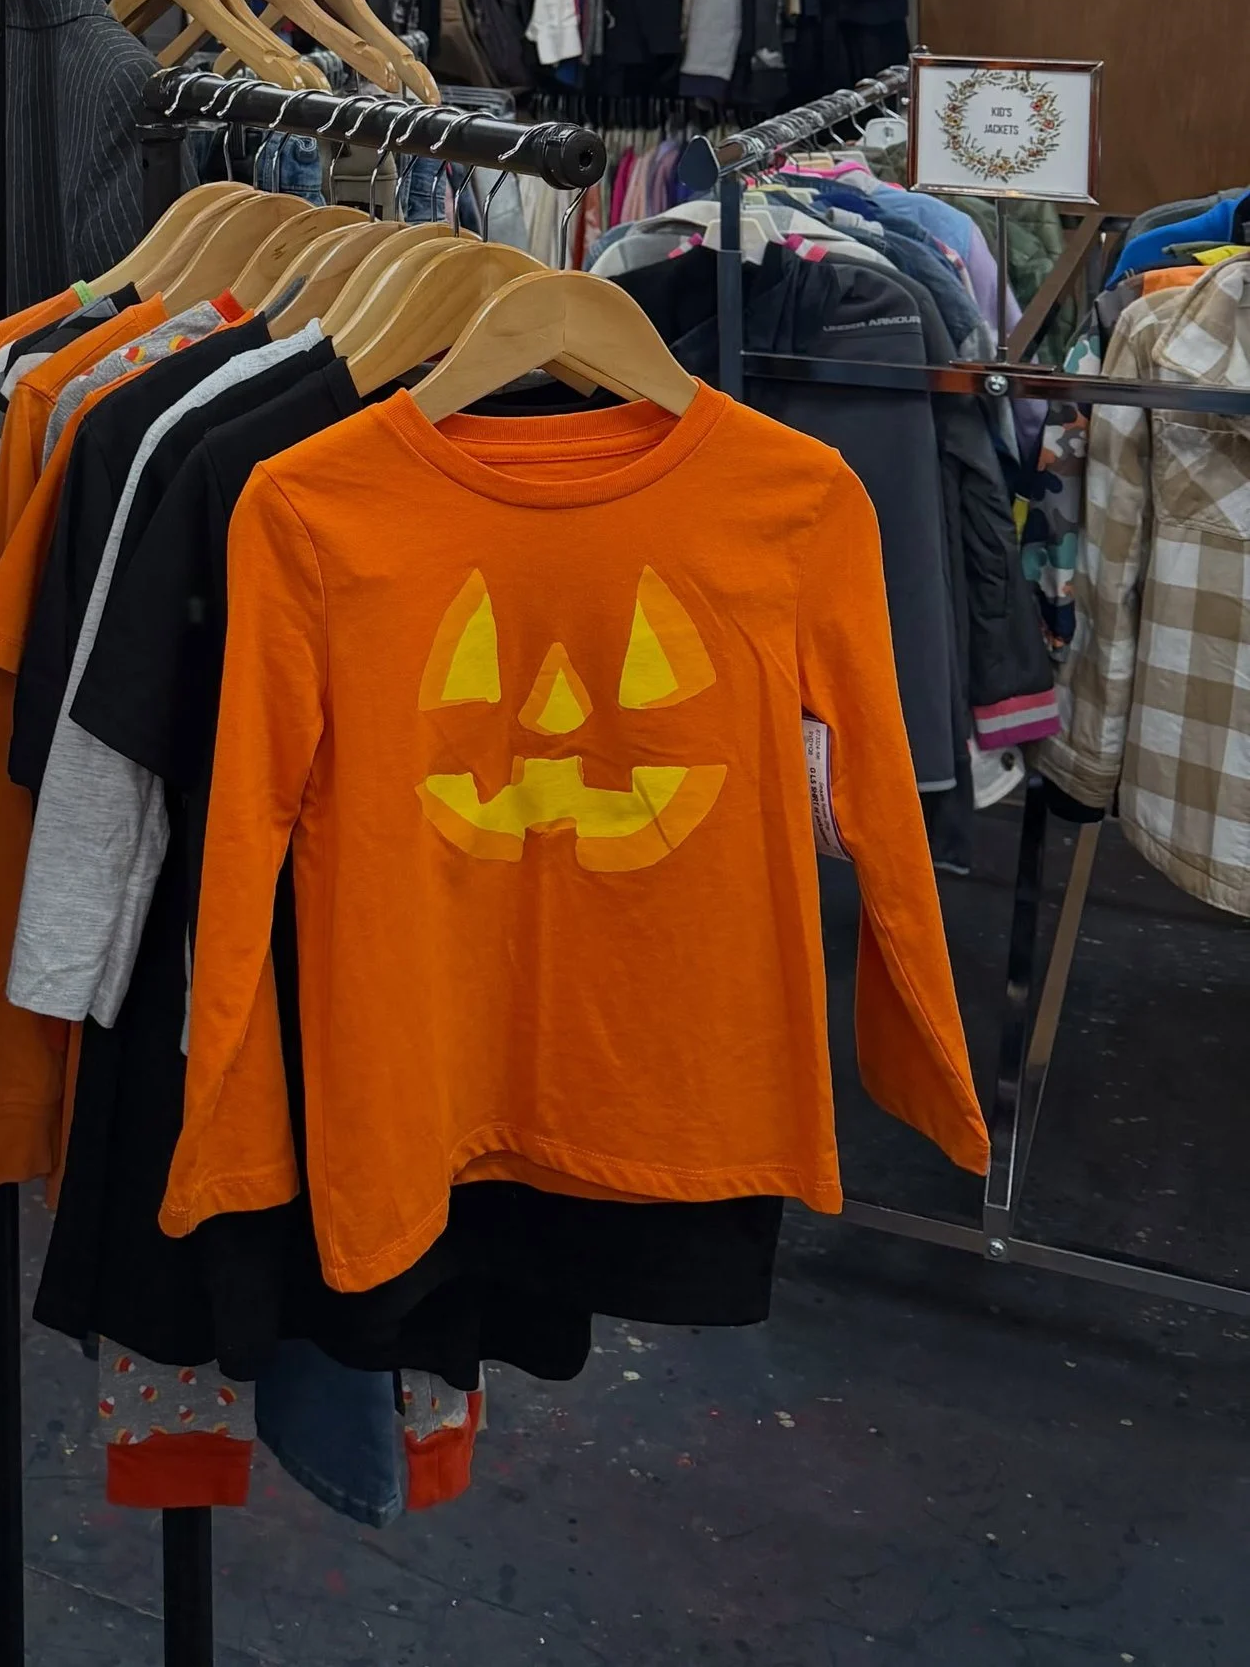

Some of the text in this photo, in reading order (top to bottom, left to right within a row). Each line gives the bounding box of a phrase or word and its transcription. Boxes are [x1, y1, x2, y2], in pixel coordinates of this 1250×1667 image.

[991, 106, 1012, 118] KID'S
[983, 124, 1019, 135] JACKETS
[822, 315, 921, 332] UNDER ARMOUR
